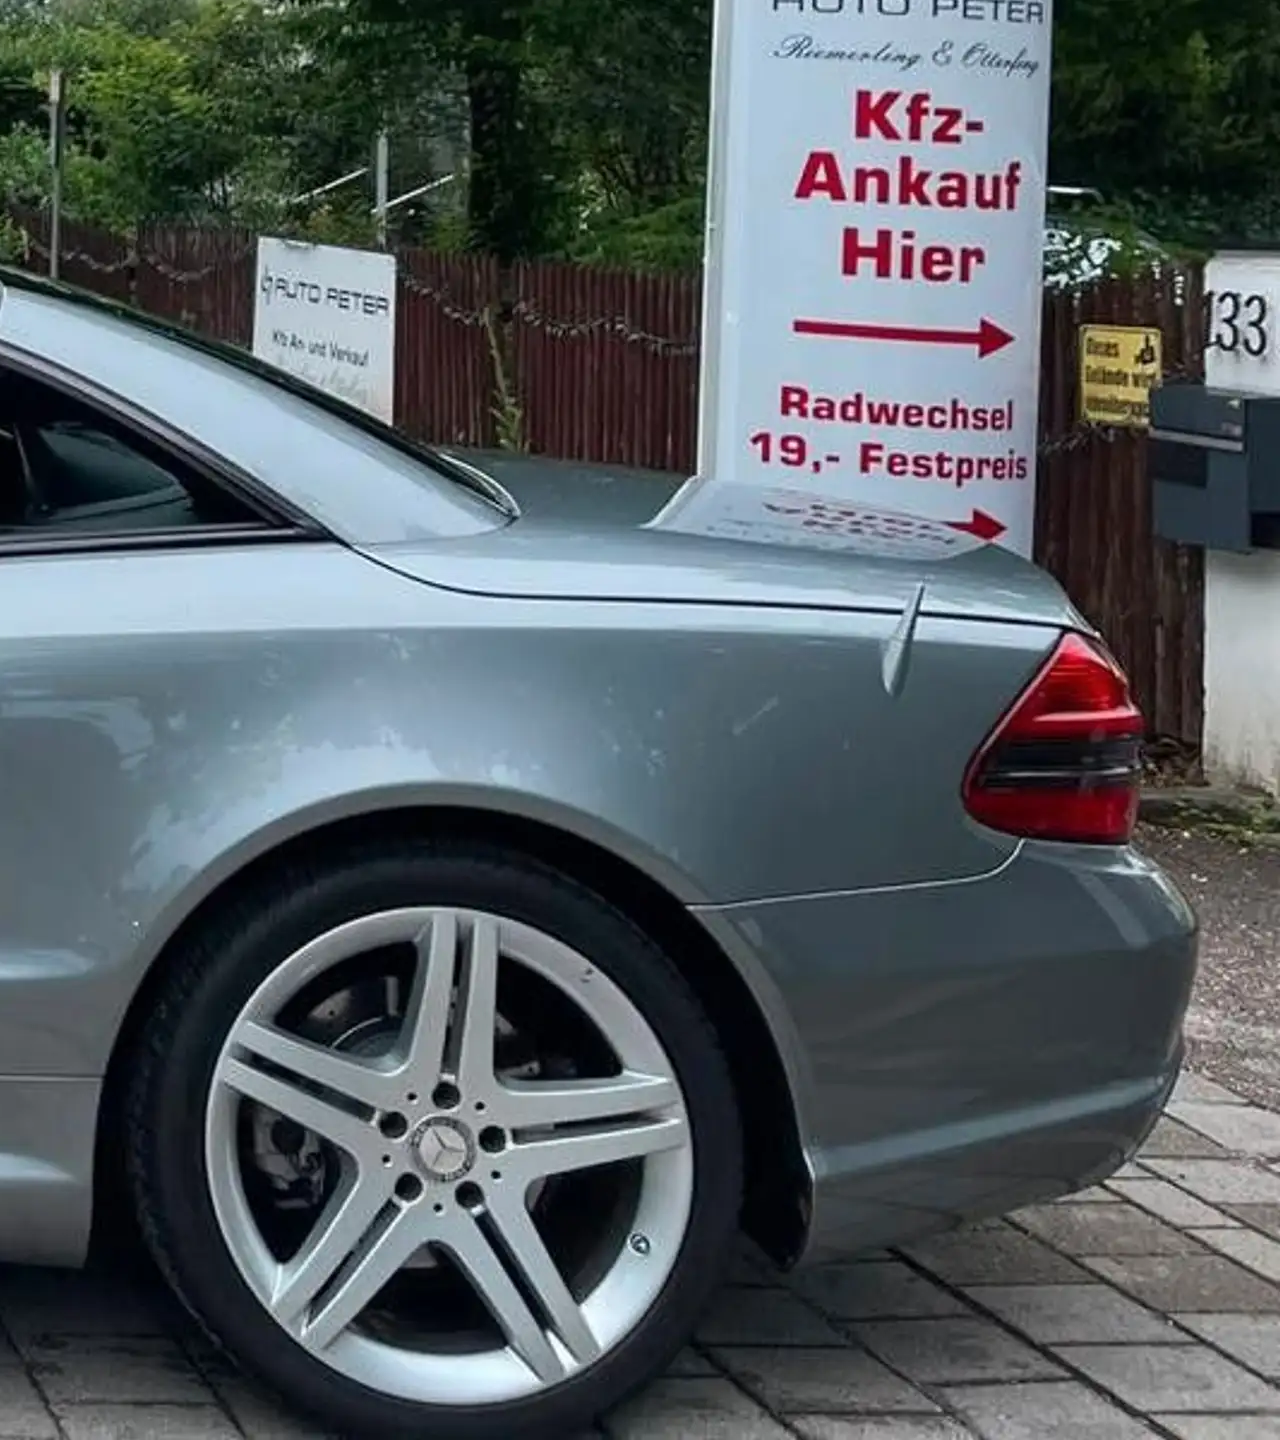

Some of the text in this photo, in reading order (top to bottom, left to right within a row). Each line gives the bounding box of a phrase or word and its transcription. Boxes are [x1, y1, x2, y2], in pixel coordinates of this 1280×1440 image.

[931, 41, 954, 68] &
[855, 90, 984, 143] Kfz-
[794, 151, 1022, 211] Ankauf
[841, 227, 985, 282] Hier
[275, 277, 321, 304] AUTO
[327, 287, 389, 315] PETER
[780, 385, 1013, 431] Radwechsel
[750, 432, 1028, 488] 19,- Festpreis
